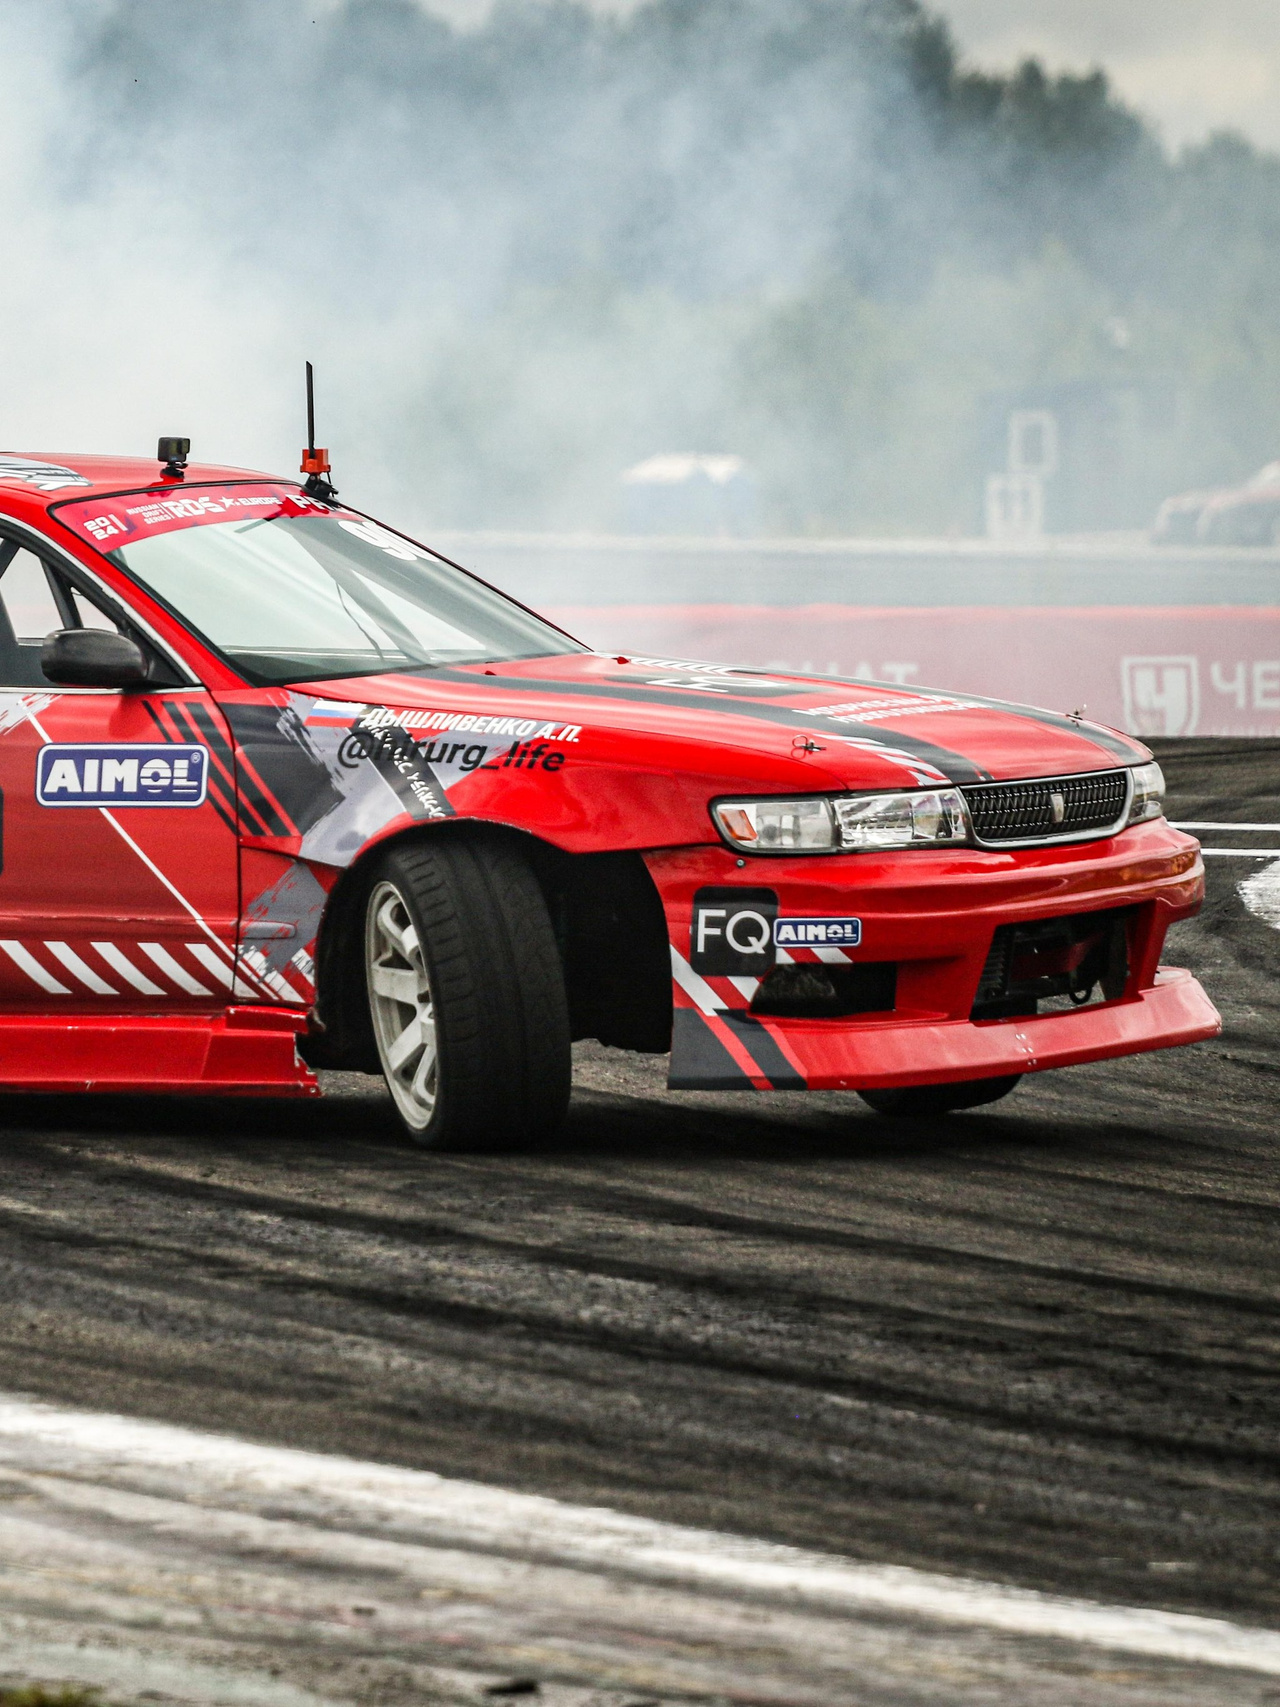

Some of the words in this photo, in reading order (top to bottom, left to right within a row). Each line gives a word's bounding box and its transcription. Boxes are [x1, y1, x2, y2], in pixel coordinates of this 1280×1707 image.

[126, 503, 161, 516] RUSSIAN
[142, 510, 166, 519] DRIFT
[161, 496, 225, 517] RDS
[238, 497, 283, 506] EUROPE
[83, 516, 111, 532] 20
[143, 514, 172, 525] SERIES
[92, 525, 119, 540] 24
[359, 708, 531, 737] ДЫШЛИВЕНКО
[531, 723, 582, 743] А.П.
[337, 731, 566, 772] @hirurg_life
[43, 758, 199, 793] AIMOL
[696, 908, 771, 955] FQ
[777, 924, 857, 941] AIMOL
